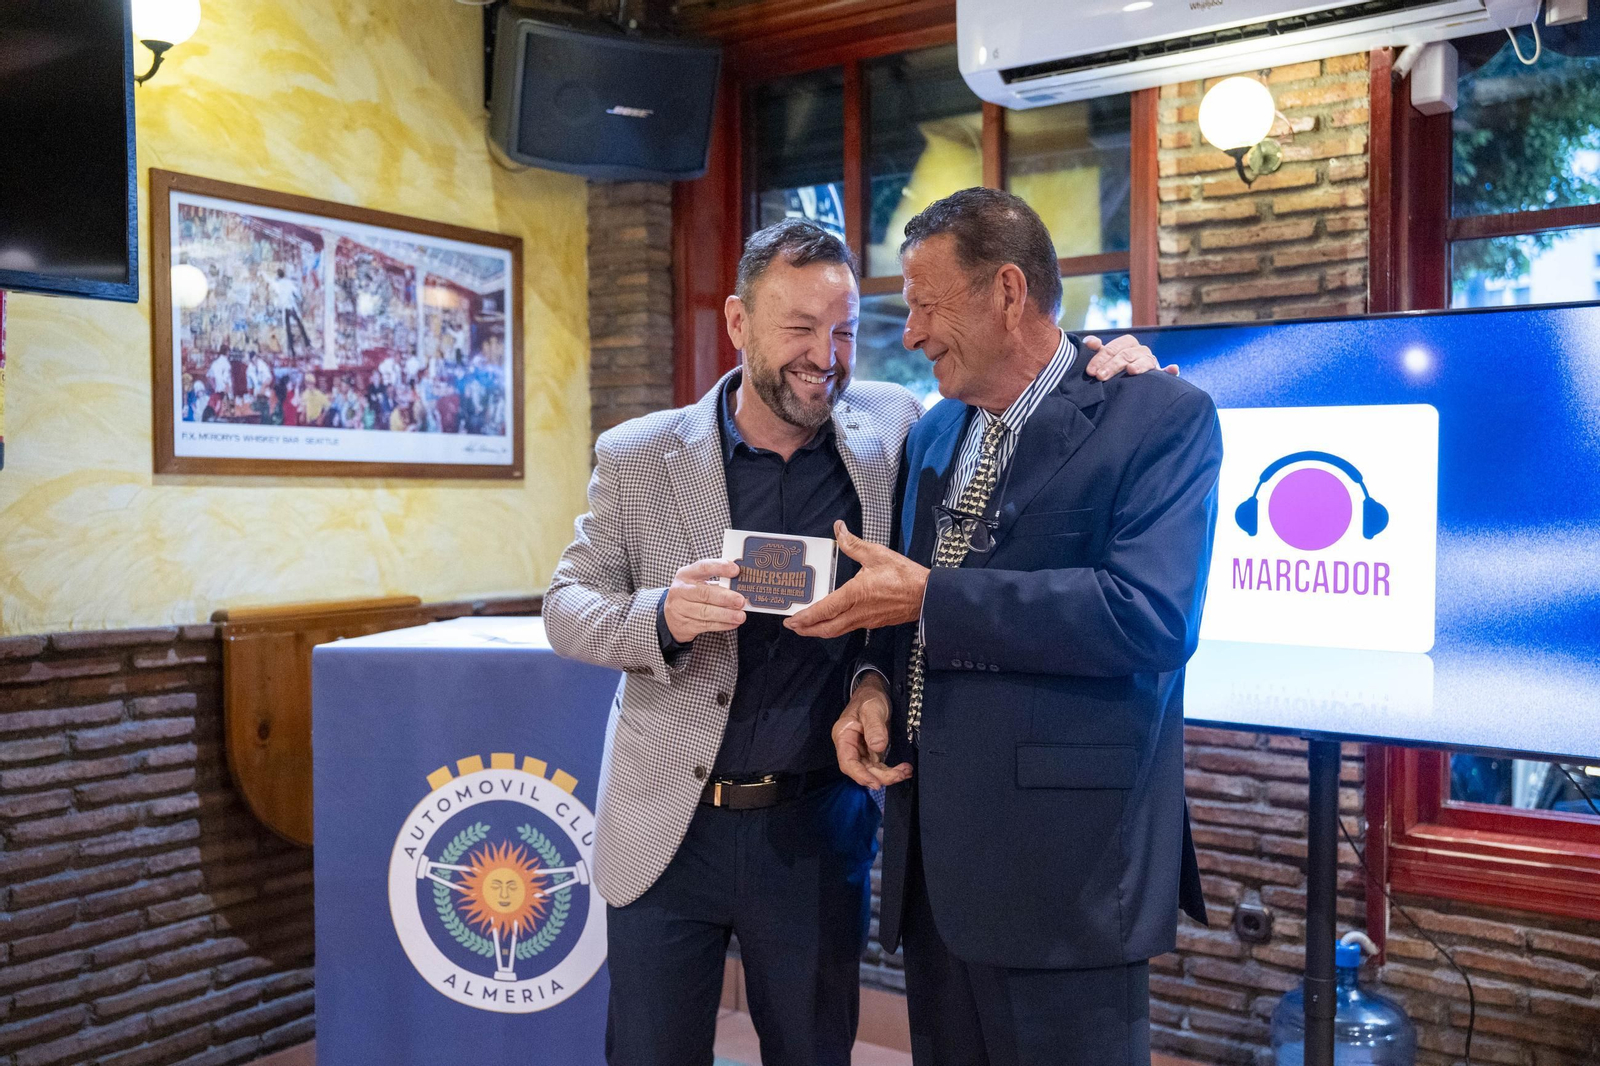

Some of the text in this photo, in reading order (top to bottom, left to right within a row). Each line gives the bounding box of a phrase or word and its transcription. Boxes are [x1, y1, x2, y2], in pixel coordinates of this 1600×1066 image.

[606, 105, 653, 118] BOSE
[243, 434, 280, 444] WHISKEY
[282, 436, 299, 445] BAR
[305, 437, 340, 446] SEATTLE
[738, 566, 806, 587] ANIVERSARIO
[1232, 557, 1391, 597] MARCADOR
[756, 585, 772, 594] COSTA
[772, 587, 780, 595] DE
[755, 595, 785, 604] 1964-2024
[404, 779, 593, 859] AUTOMOVIL CLU
[443, 973, 564, 1004] ALMERIA
